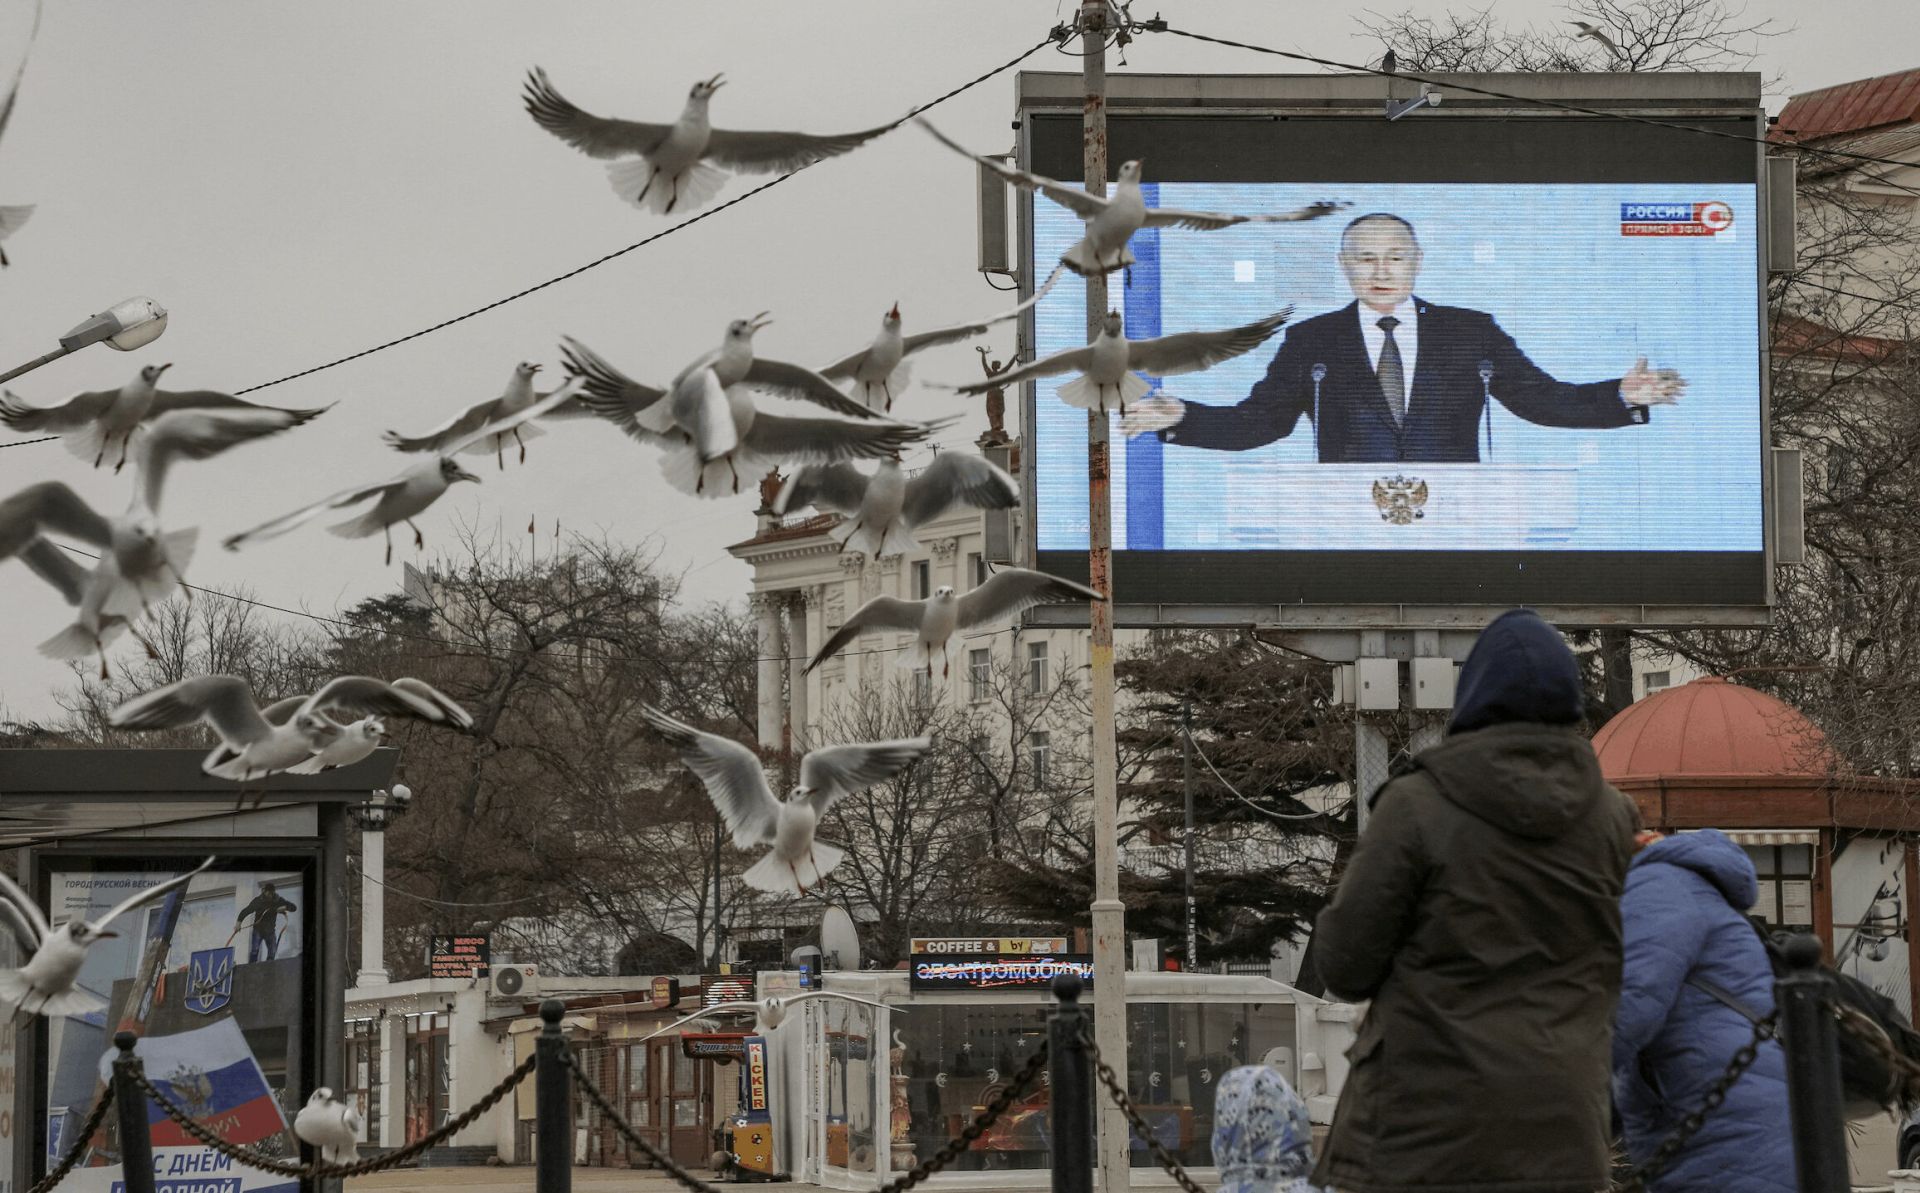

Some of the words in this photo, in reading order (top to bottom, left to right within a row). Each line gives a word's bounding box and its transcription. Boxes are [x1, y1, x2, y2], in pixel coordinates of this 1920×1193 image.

[1626, 206, 1686, 219] РОССИЯ
[1625, 224, 1674, 234] ПРЯМОЙ
[65, 880, 92, 889] ГОРОД
[94, 878, 131, 889] РУССКОЙ
[926, 941, 983, 953] COFFEE
[985, 942, 996, 952] &
[1010, 940, 1023, 951] by
[750, 1045, 764, 1108] KICKER
[153, 1155, 164, 1174] С
[167, 1149, 232, 1176] ДНЁМ
